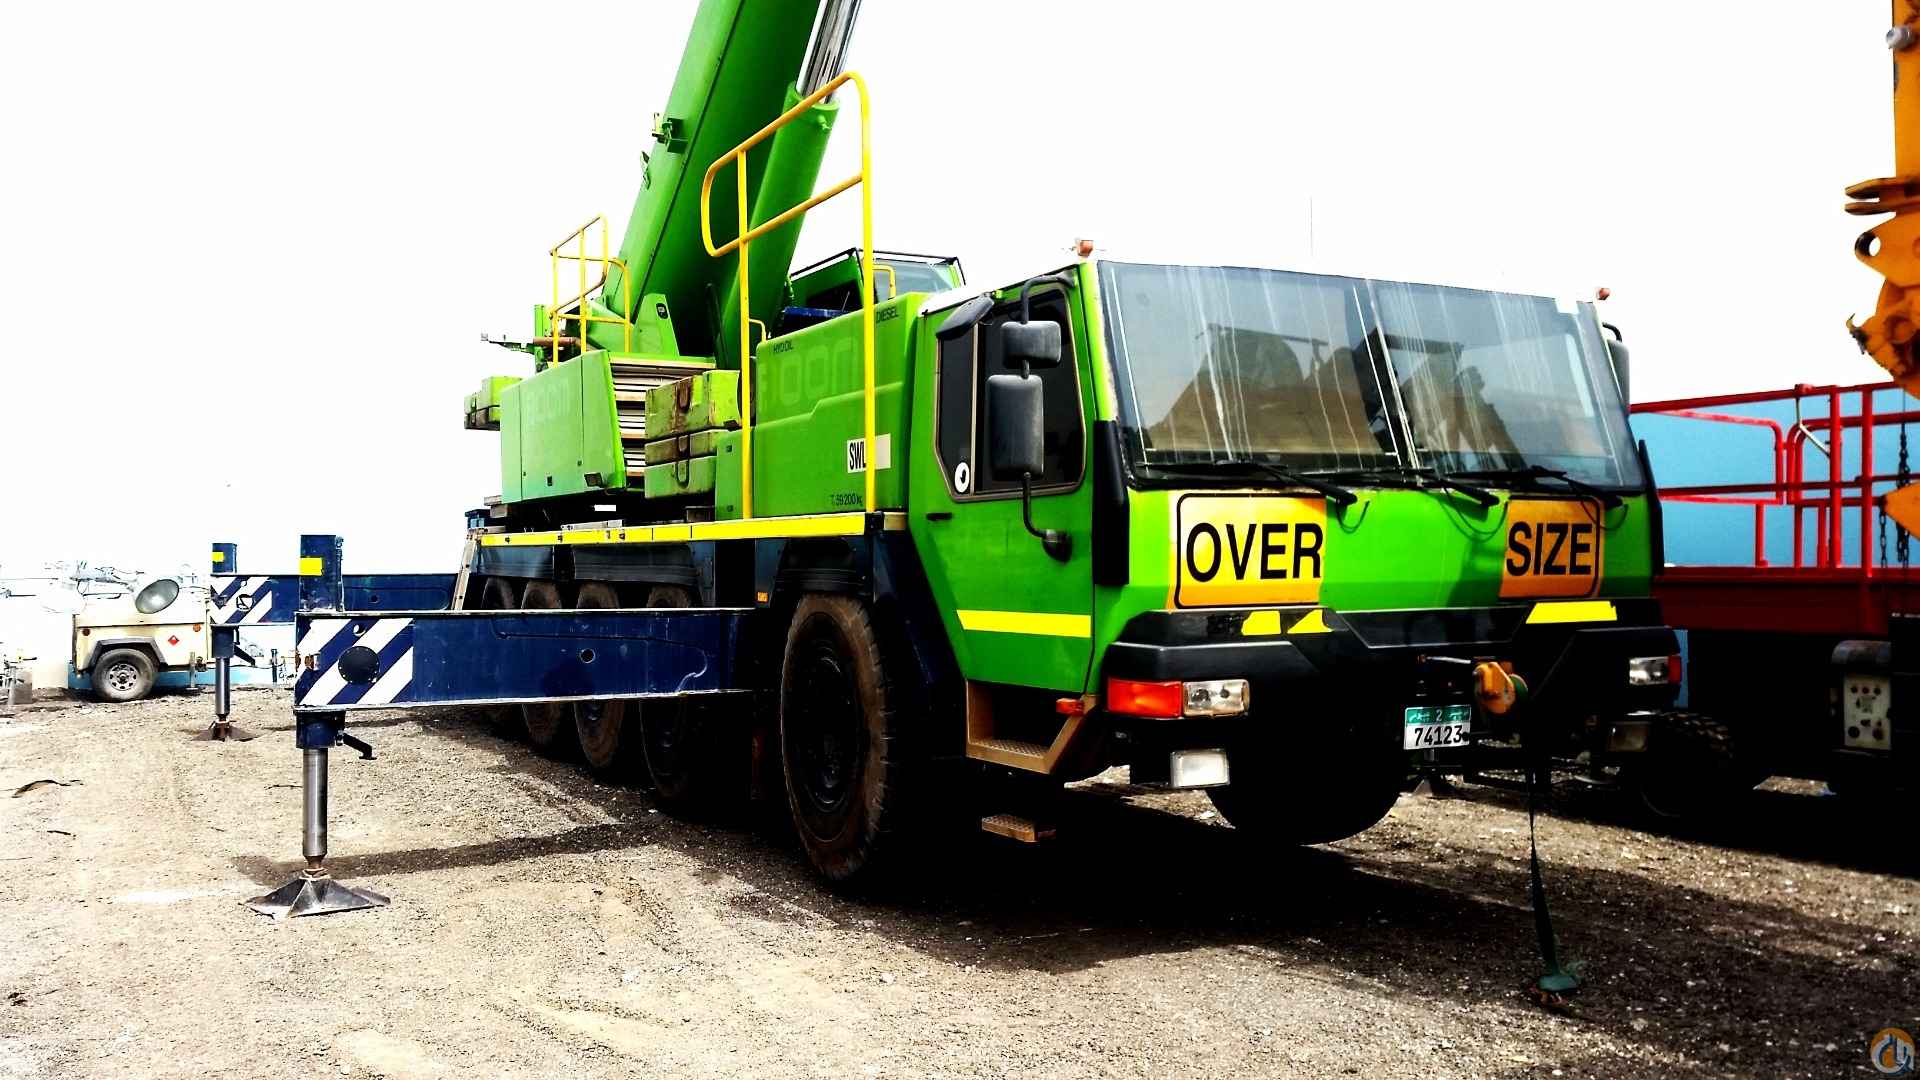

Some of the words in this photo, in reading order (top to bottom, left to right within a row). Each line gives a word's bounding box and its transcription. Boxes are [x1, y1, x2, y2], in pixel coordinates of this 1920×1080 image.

[876, 306, 898, 322] DIESEL
[850, 441, 866, 470] SWL
[1186, 522, 1323, 583] OVER
[1506, 521, 1592, 577] SIZE
[1436, 709, 1443, 721] 2
[1415, 725, 1462, 746] 74123
